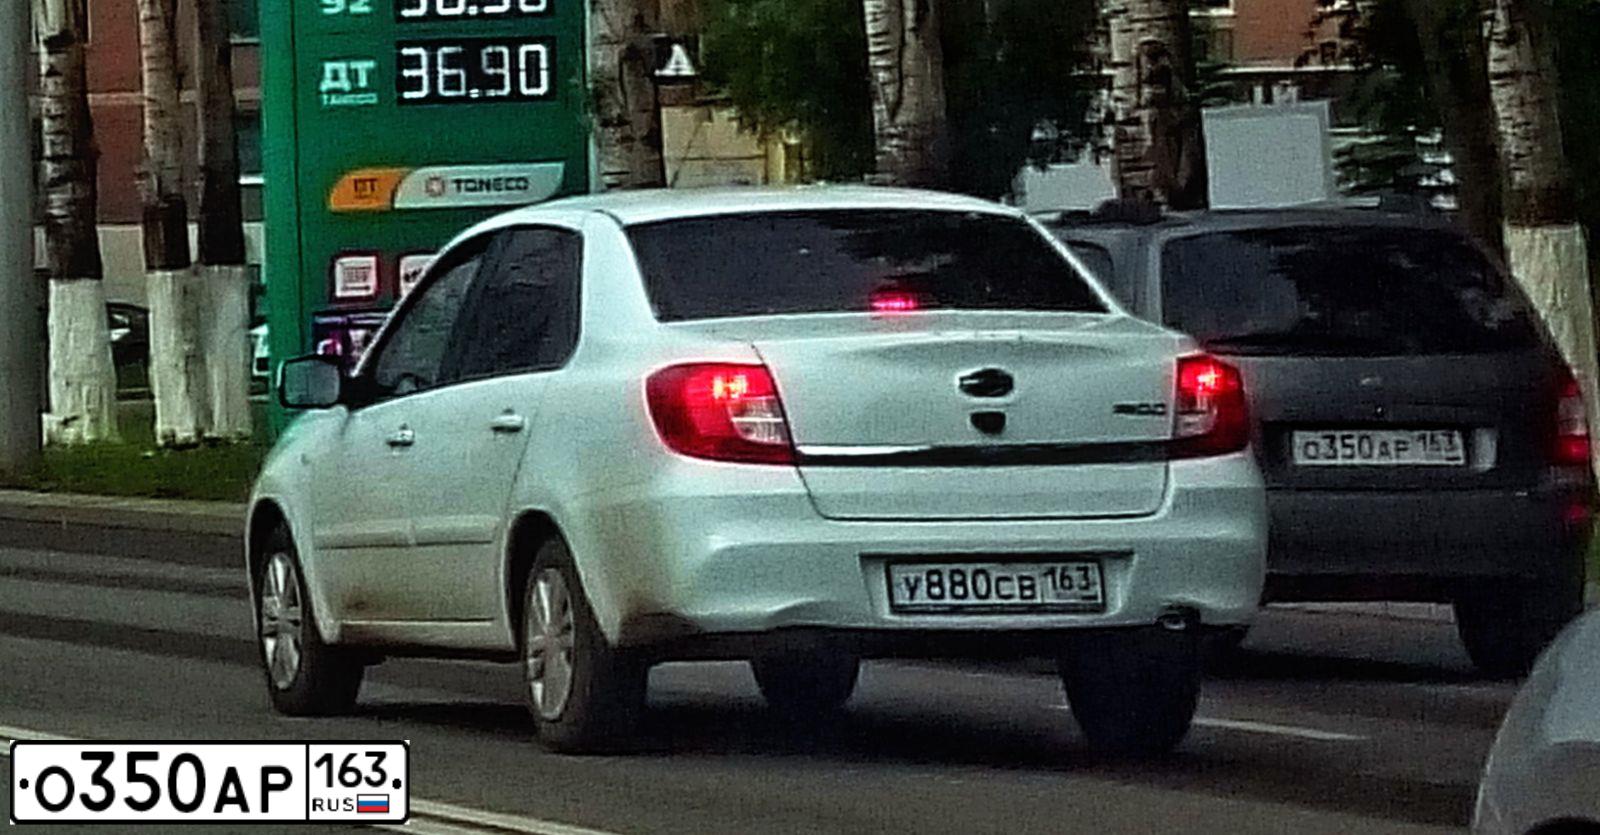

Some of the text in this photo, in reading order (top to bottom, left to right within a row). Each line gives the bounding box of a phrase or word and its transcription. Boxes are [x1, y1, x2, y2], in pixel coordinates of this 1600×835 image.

[320, 44, 549, 98] ДТ 36.90
[1043, 565, 1090, 591] 163
